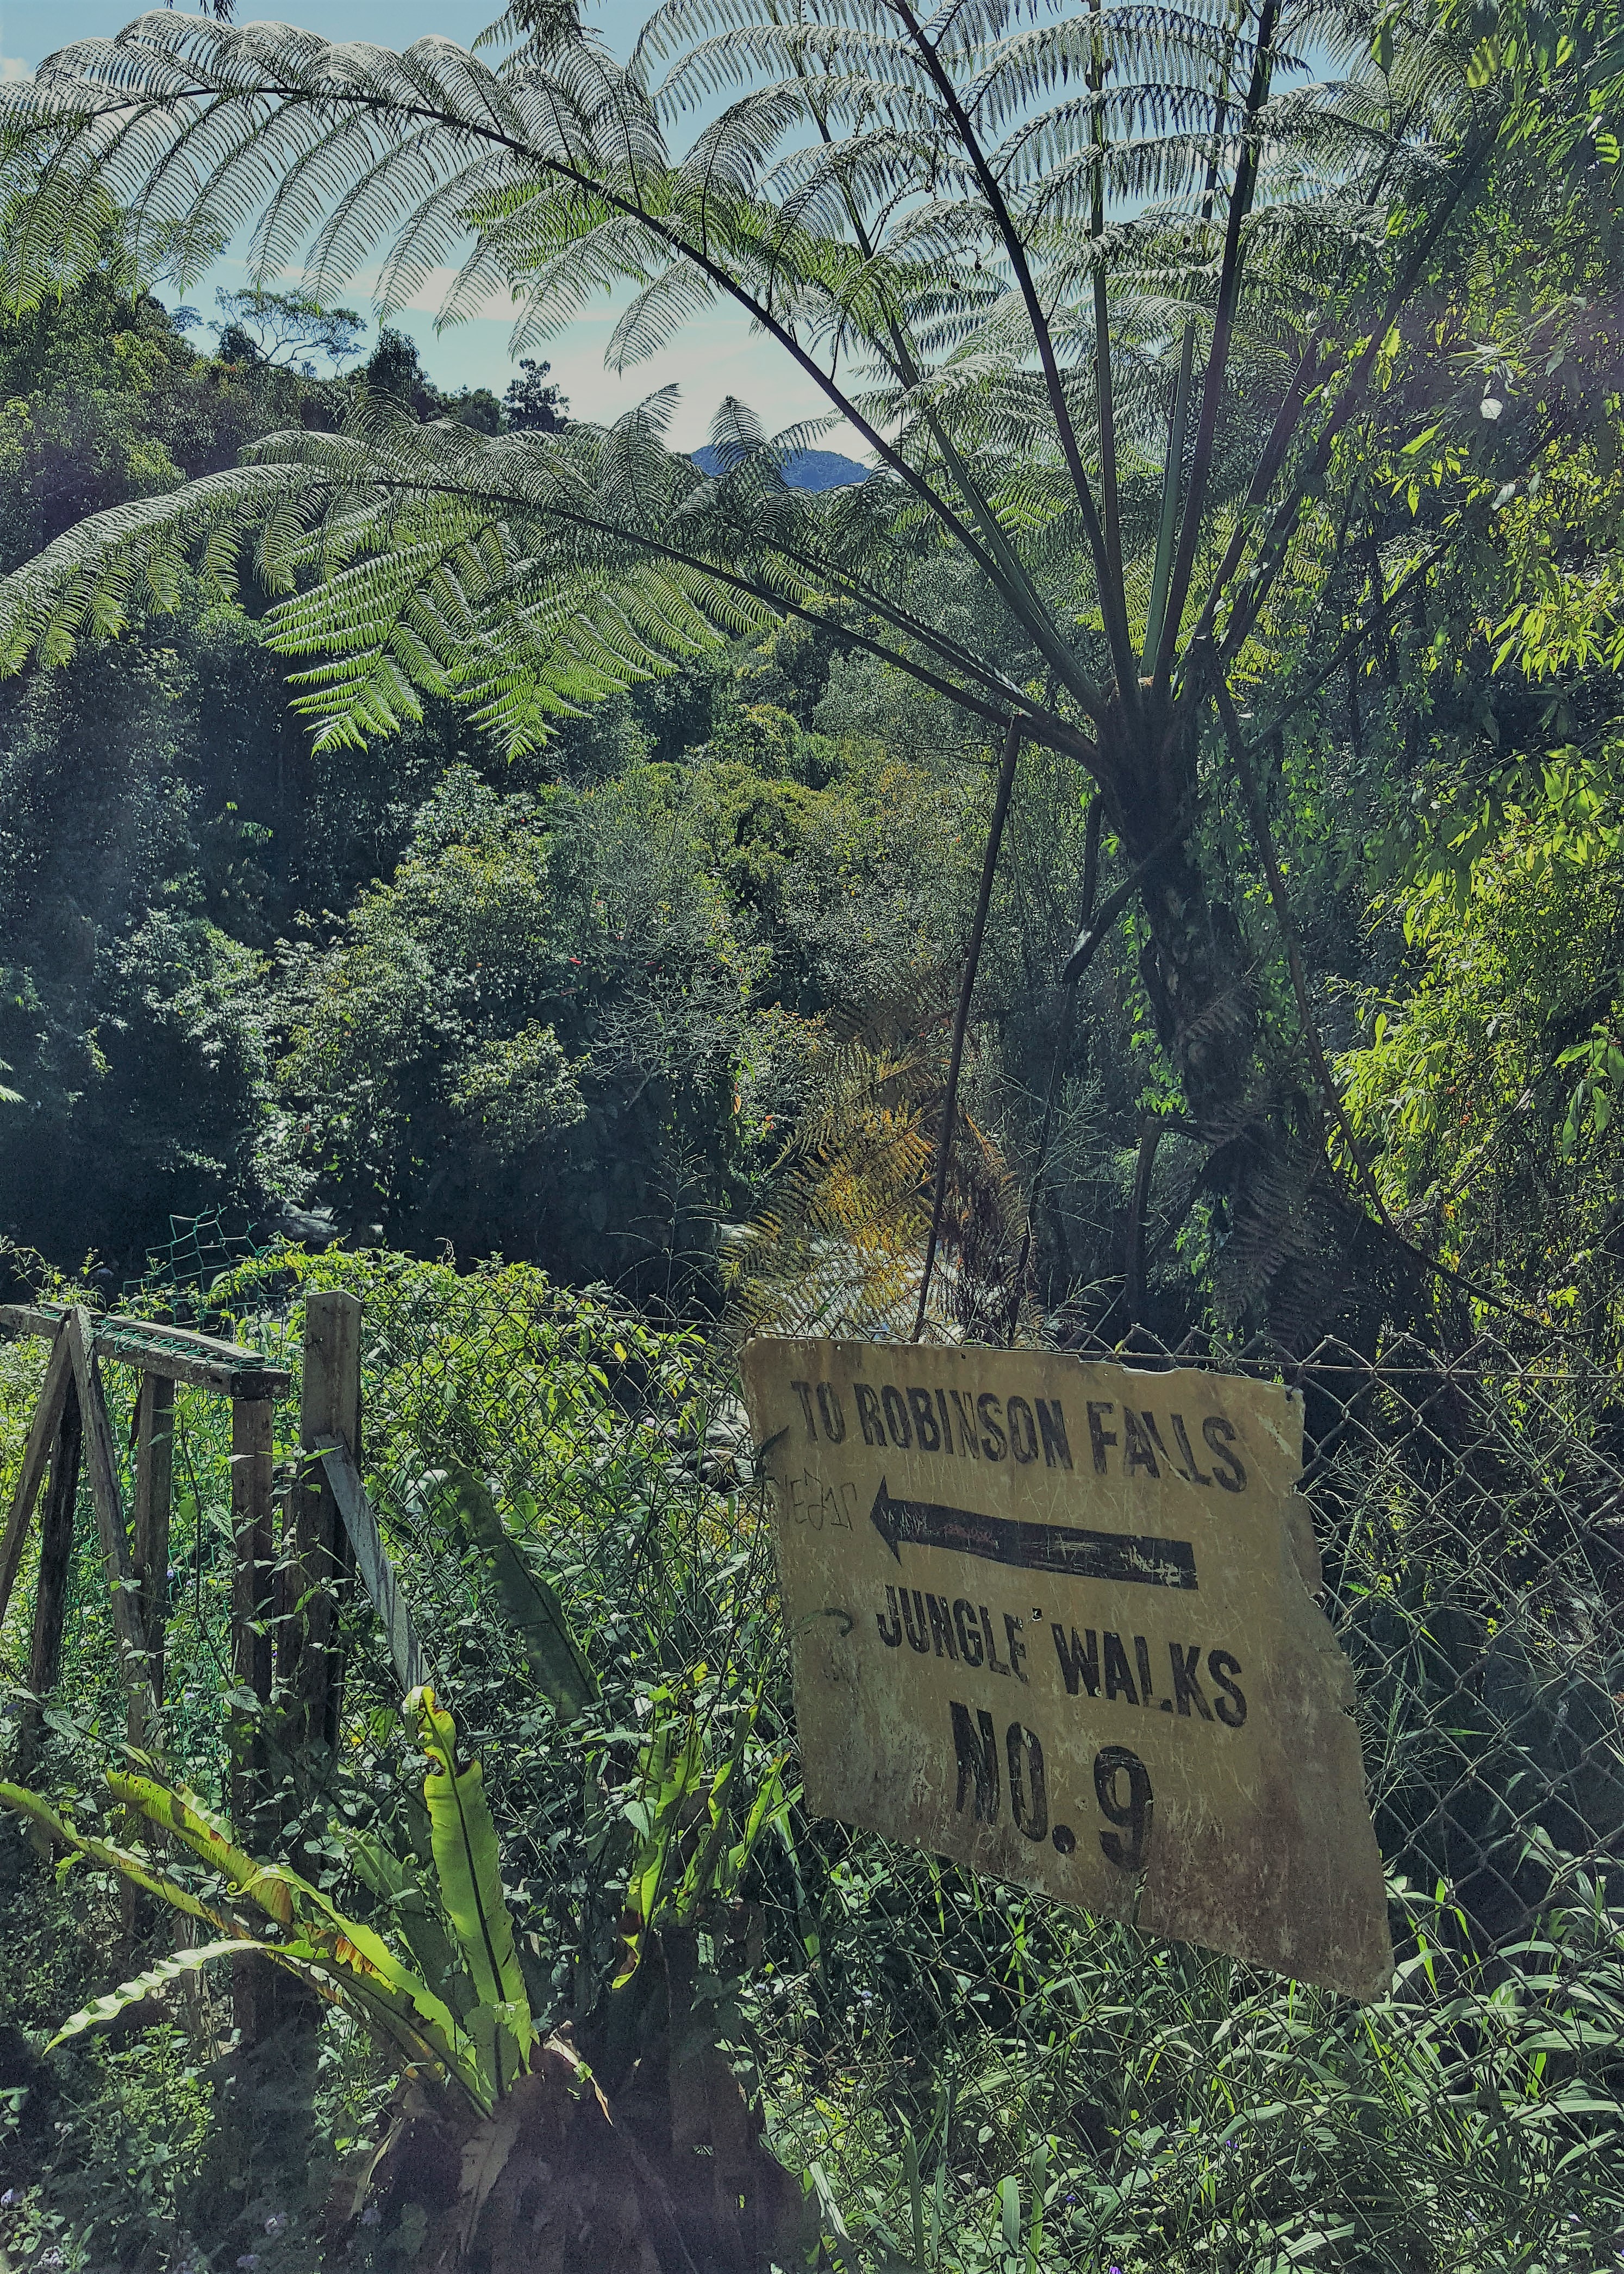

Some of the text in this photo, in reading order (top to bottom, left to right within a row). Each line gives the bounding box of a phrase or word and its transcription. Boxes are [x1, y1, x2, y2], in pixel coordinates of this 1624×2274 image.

[790, 1380, 1247, 1492] TO ROBINSON FALLS
[876, 1584, 1247, 1728] JUNGLE WALKS
